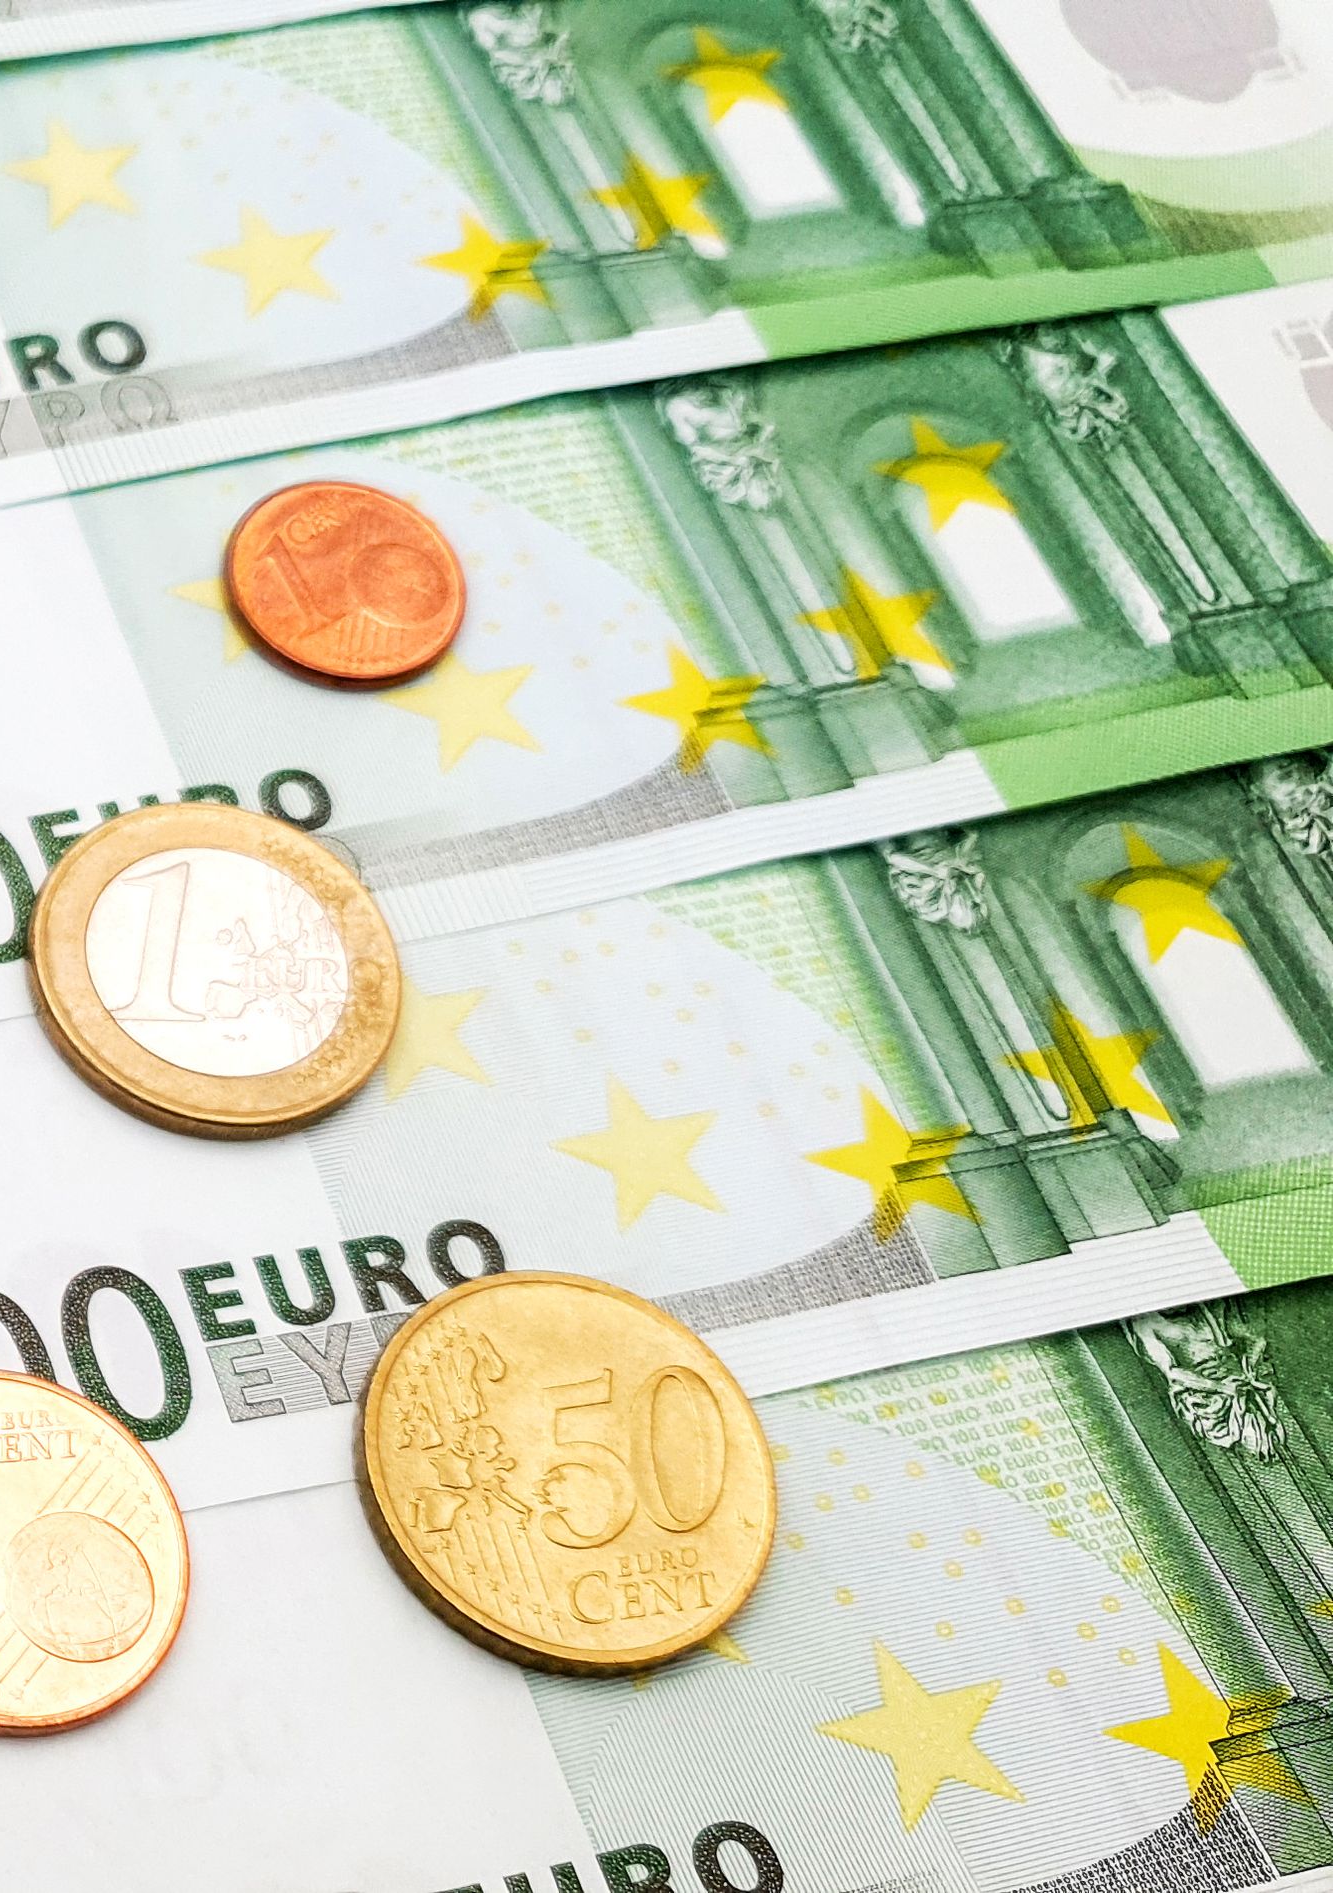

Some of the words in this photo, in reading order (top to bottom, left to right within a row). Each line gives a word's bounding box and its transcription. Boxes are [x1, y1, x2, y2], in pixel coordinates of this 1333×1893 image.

[254, 532, 348, 643] 1
[107, 861, 207, 1022] 1
[177, 1218, 506, 1342] EURO
[536, 1364, 726, 1549] 50
[567, 1570, 715, 1625] CENT
[616, 1548, 700, 1578] EURO
